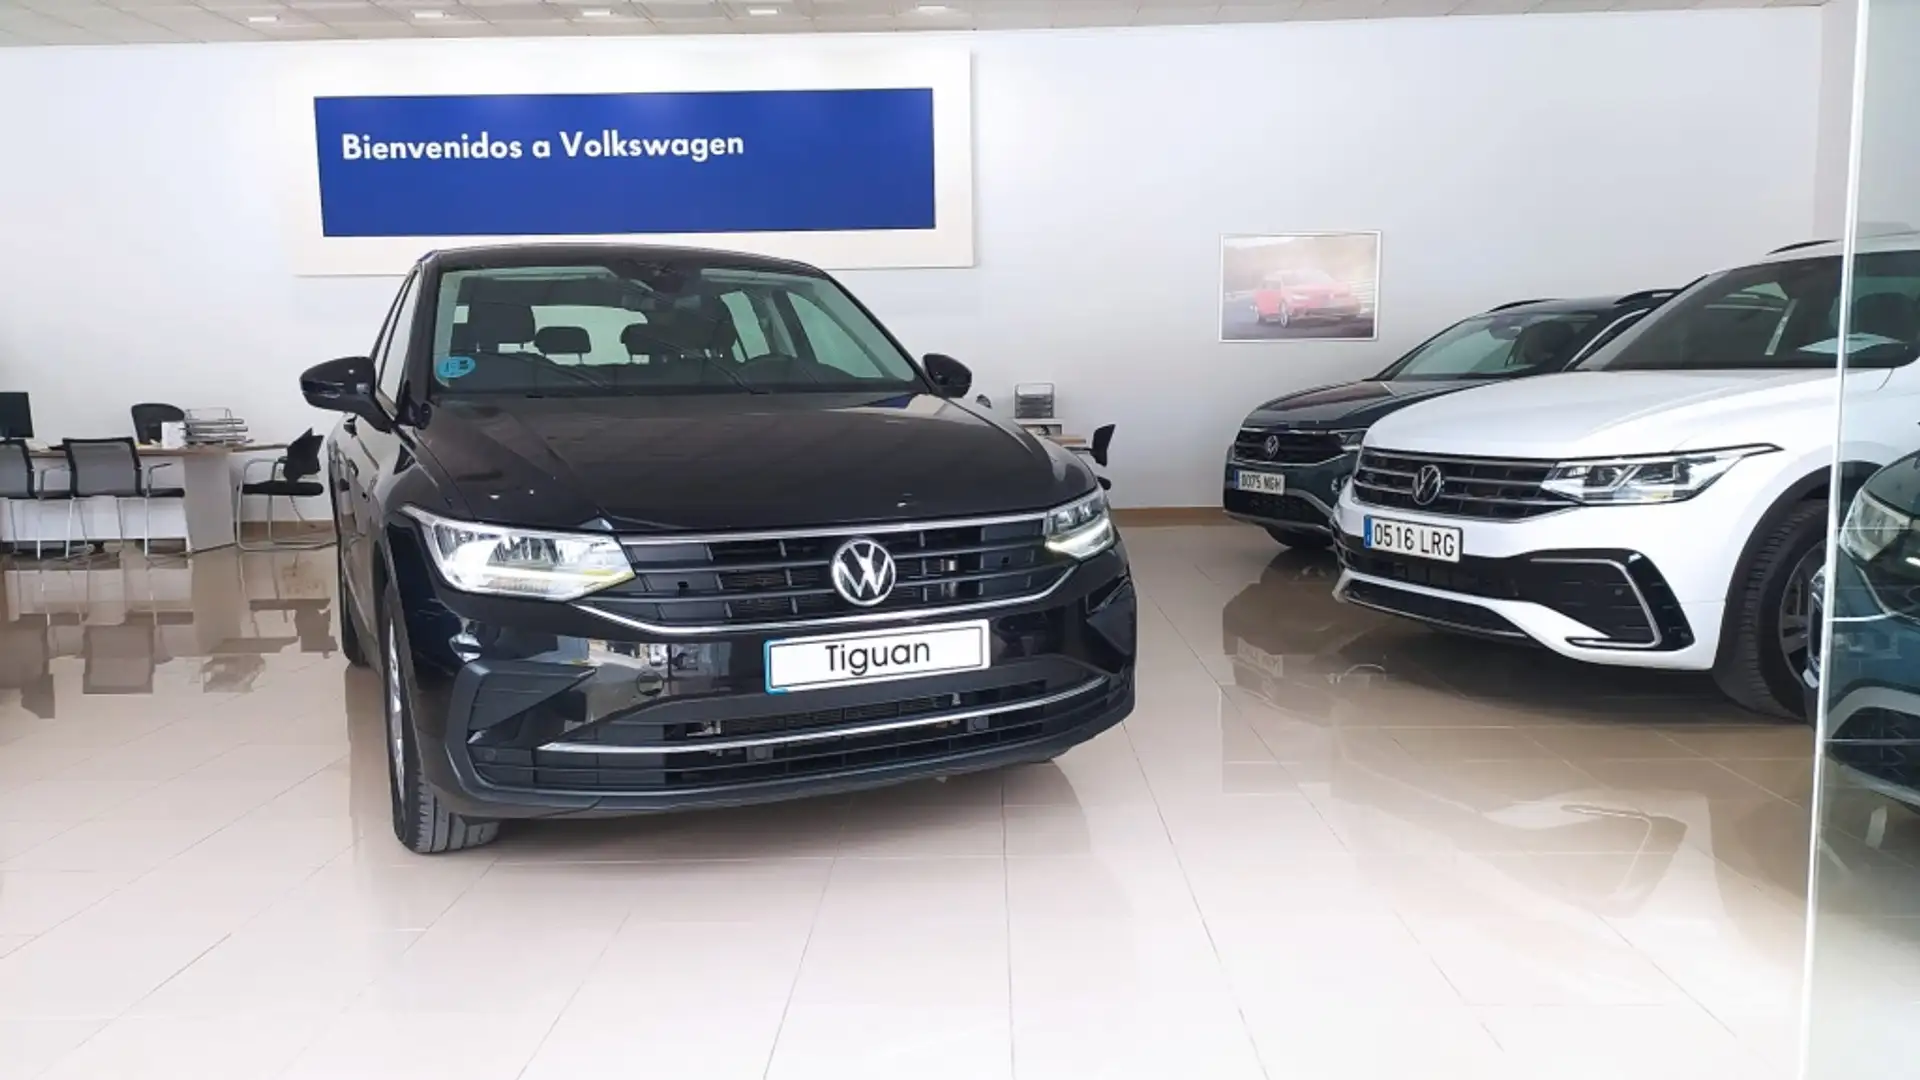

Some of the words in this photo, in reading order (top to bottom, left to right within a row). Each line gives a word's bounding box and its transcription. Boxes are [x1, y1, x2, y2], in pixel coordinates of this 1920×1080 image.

[342, 131, 523, 160] Bienvenidos
[532, 140, 550, 158] a
[558, 129, 745, 162] Volkswagen
[1374, 523, 1415, 551] 0516
[1420, 529, 1455, 557] LRG
[824, 641, 931, 675] Tiguan
